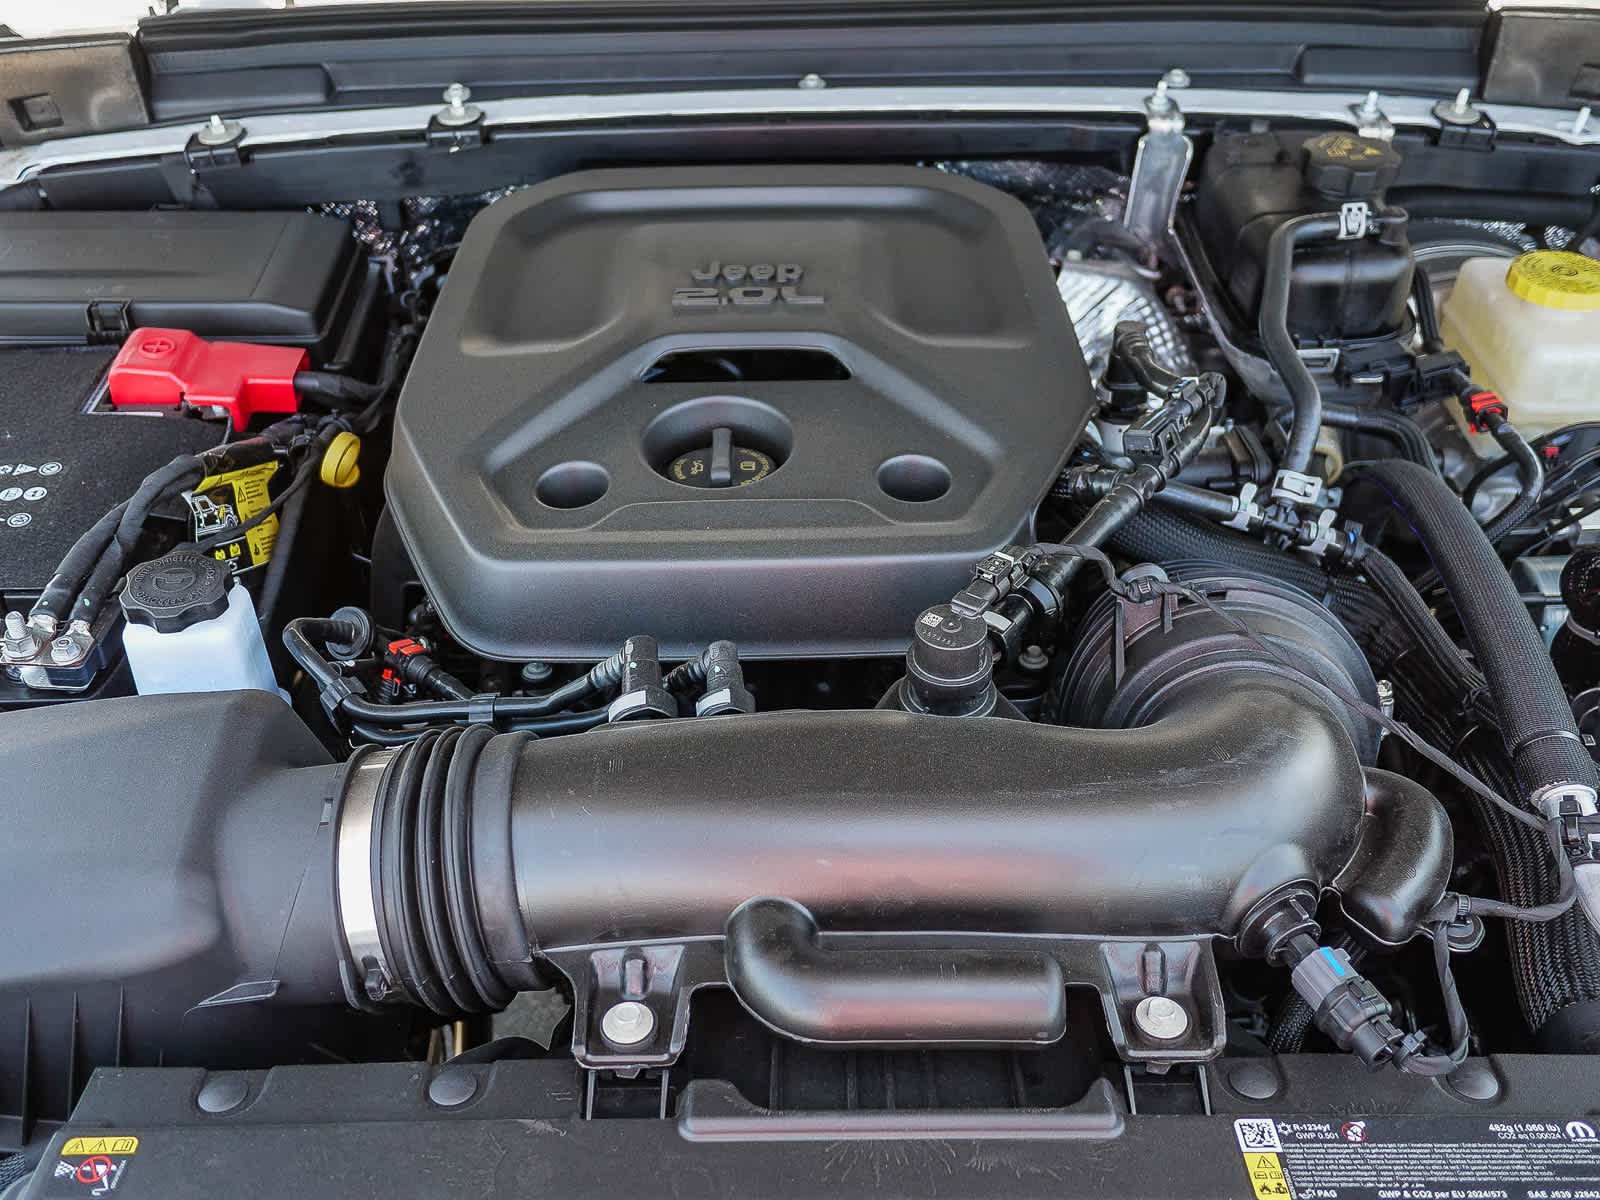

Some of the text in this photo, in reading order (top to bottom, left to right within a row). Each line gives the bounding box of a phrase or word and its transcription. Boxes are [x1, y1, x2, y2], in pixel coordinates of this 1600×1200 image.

[691, 261, 803, 287] Jeep
[672, 287, 824, 307] 2.0L
[1378, 1190, 1402, 1199] GWP
[1412, 1190, 1433, 1199] CO2
[1434, 1191, 1450, 1200] per
[1450, 1190, 1466, 1199] EU
